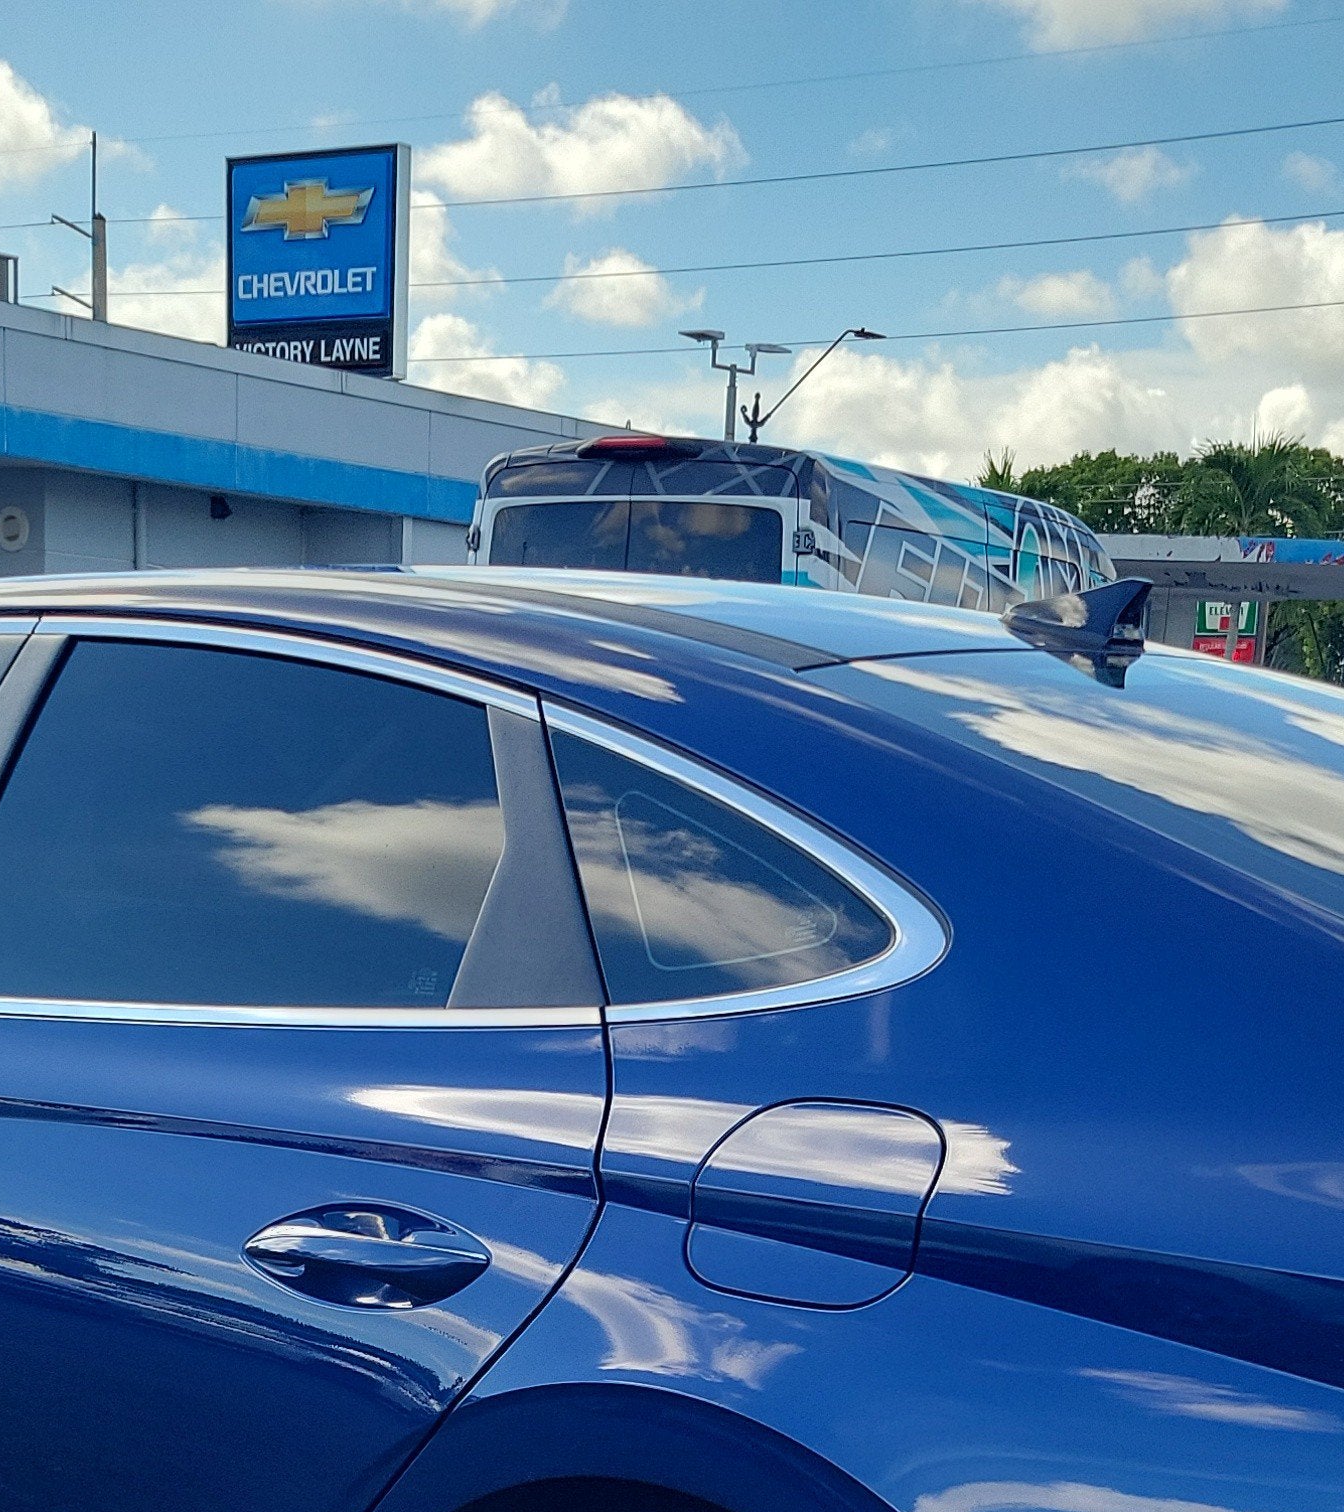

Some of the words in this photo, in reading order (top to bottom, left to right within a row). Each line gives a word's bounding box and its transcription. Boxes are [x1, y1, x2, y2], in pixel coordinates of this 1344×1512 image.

[238, 267, 377, 299] CHEVROLET
[236, 340, 315, 363] CTORY
[320, 337, 381, 362] LAYNE
